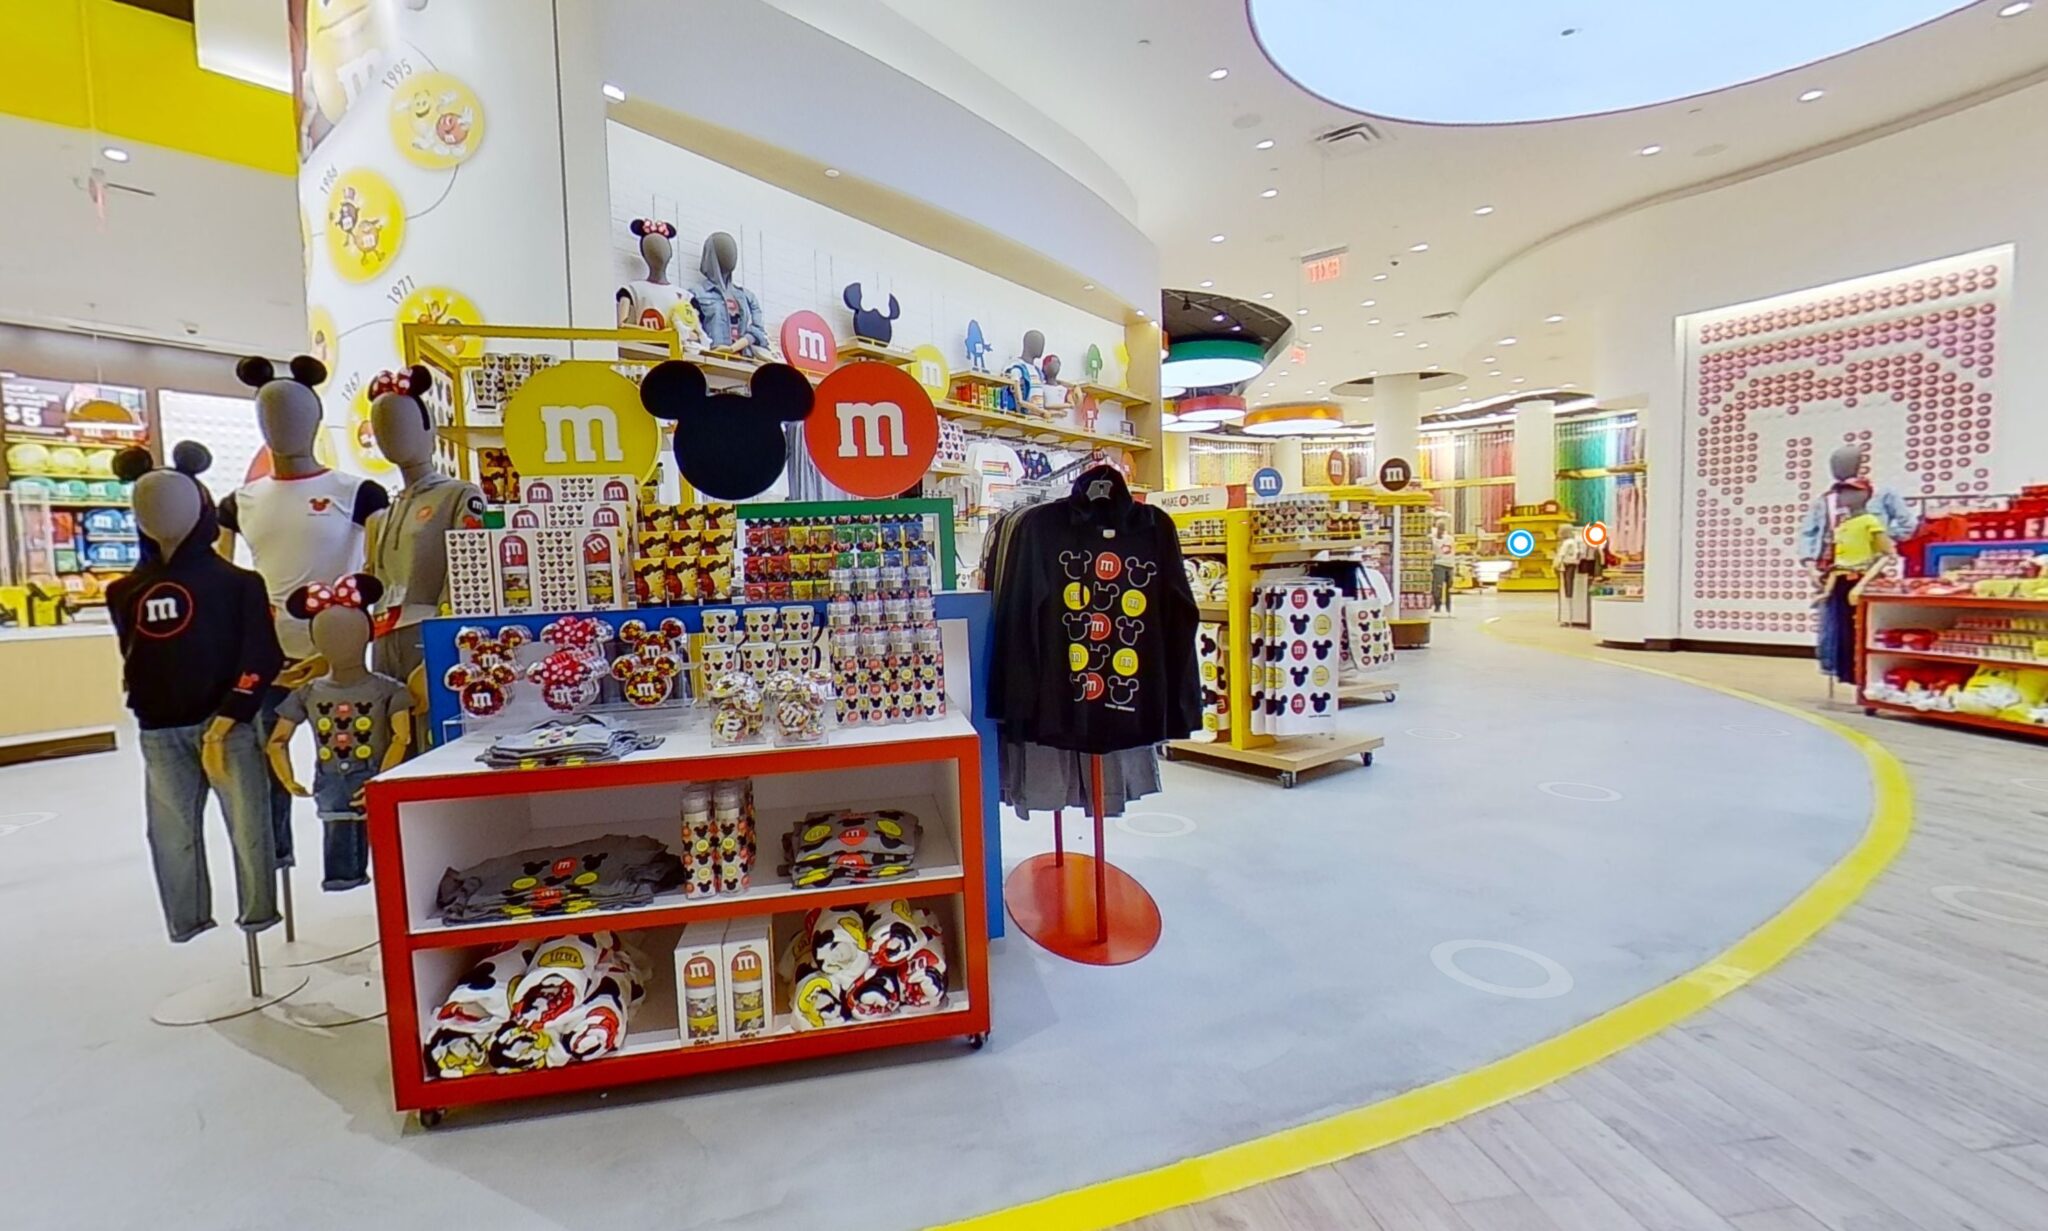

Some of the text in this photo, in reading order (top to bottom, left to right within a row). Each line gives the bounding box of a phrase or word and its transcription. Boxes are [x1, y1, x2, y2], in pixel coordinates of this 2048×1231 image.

[381, 58, 413, 90] 1995
[386, 275, 415, 305] 1971
[798, 328, 827, 362] m
[921, 360, 942, 388] m
[4, 404, 42, 427] $5
[540, 405, 624, 463] m
[836, 401, 909, 458] m
[1331, 460, 1342, 476] m
[1385, 467, 1404, 482] m
[1259, 476, 1277, 490] m
[532, 487, 548, 499] m
[608, 486, 625, 498] m
[472, 500, 483, 509] m
[1161, 496, 1179, 507] MAKE
[1190, 493, 1211, 506] SMILE
[517, 514, 537, 527] m
[598, 511, 614, 524] m
[504, 542, 523, 556] m
[587, 537, 608, 554] m
[1100, 560, 1114, 572] m
[146, 596, 179, 621] m
[1091, 620, 1104, 632] m
[645, 645, 661, 658] m
[637, 683, 656, 696] m
[471, 692, 492, 708] m
[558, 861, 570, 870] m
[690, 962, 709, 978] m
[737, 955, 756, 971] m
